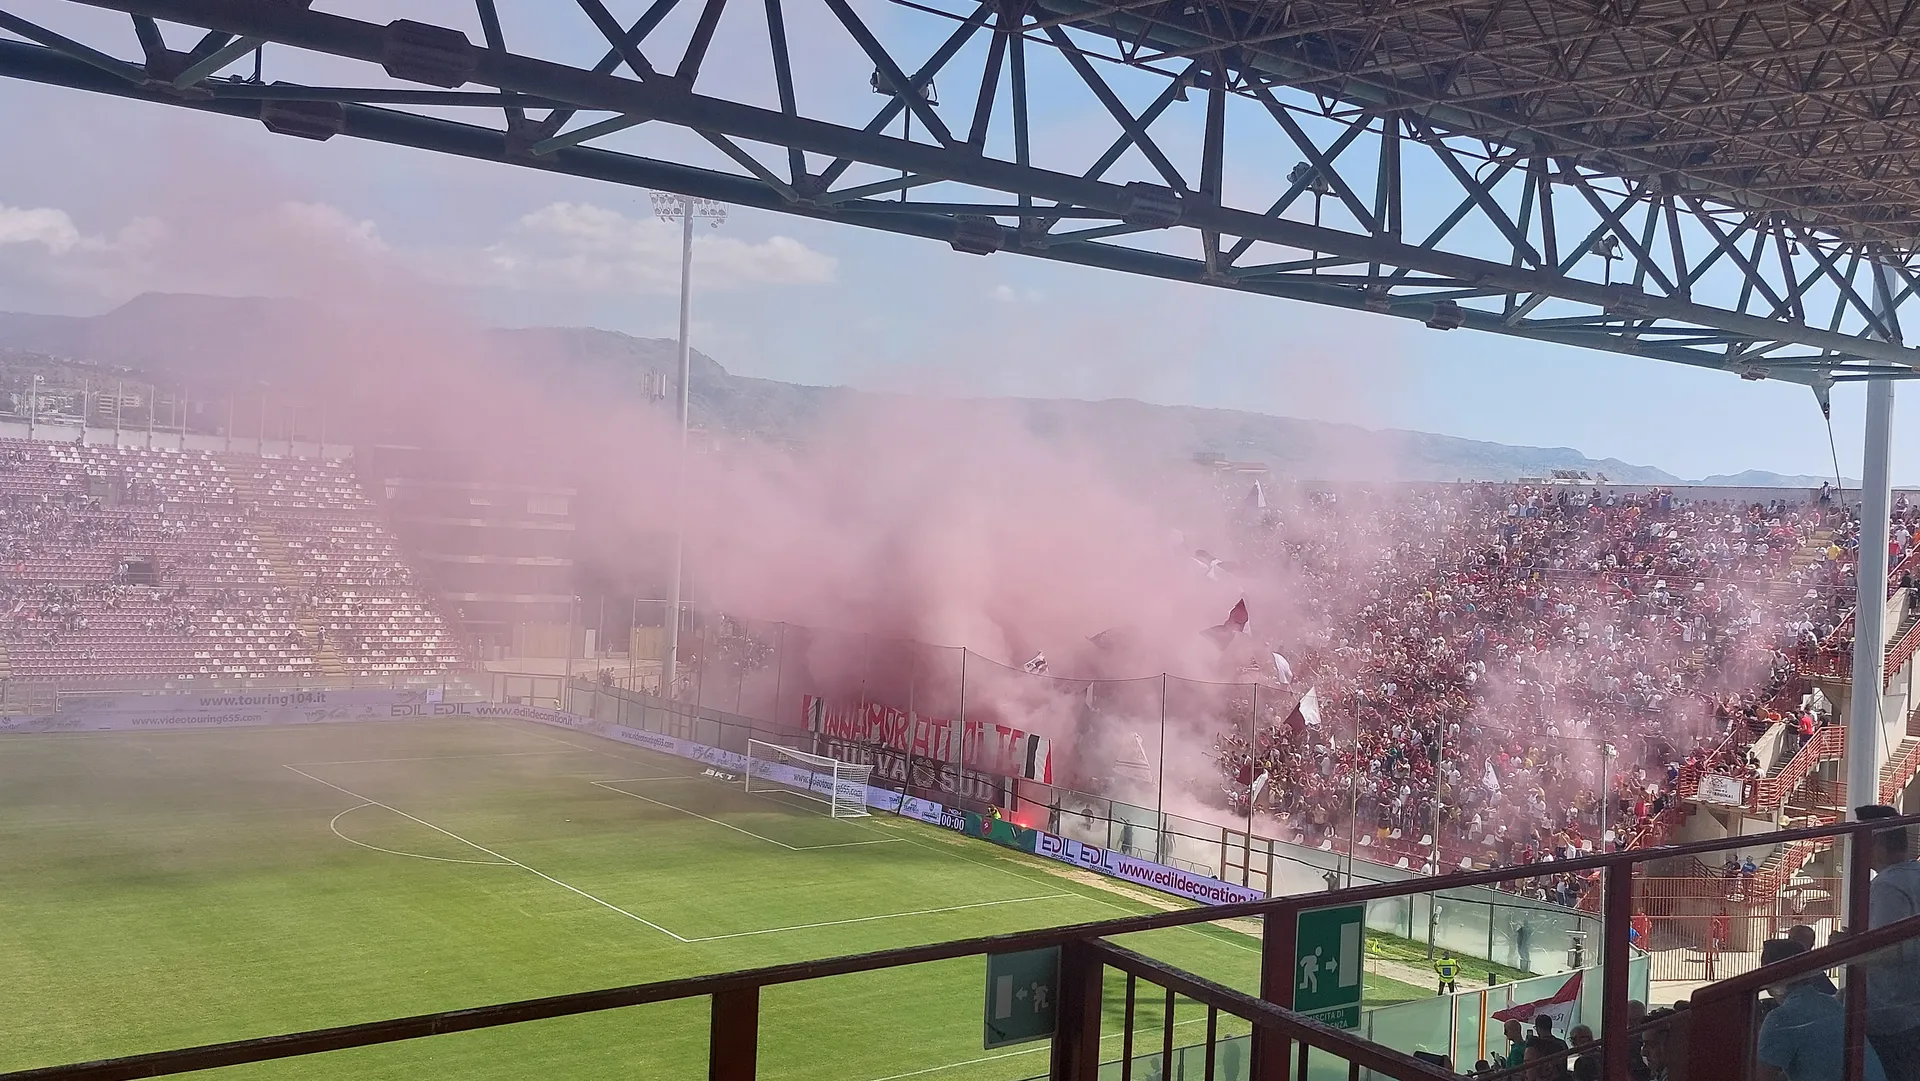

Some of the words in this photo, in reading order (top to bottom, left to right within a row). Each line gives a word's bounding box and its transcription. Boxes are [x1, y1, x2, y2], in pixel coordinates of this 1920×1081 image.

[199, 692, 327, 707] www.touring104.it
[391, 703, 427, 717] EDIL
[434, 702, 471, 716] EDIL
[476, 706, 574, 726] www.edildecoration.it
[131, 713, 263, 725] www.videotouring655.com
[939, 763, 995, 803] SUD
[941, 814, 965, 831] 00:00
[1042, 832, 1074, 858] EDIL
[1080, 843, 1113, 870] EDIL
[1118, 860, 1258, 903] www.edildecorationi
